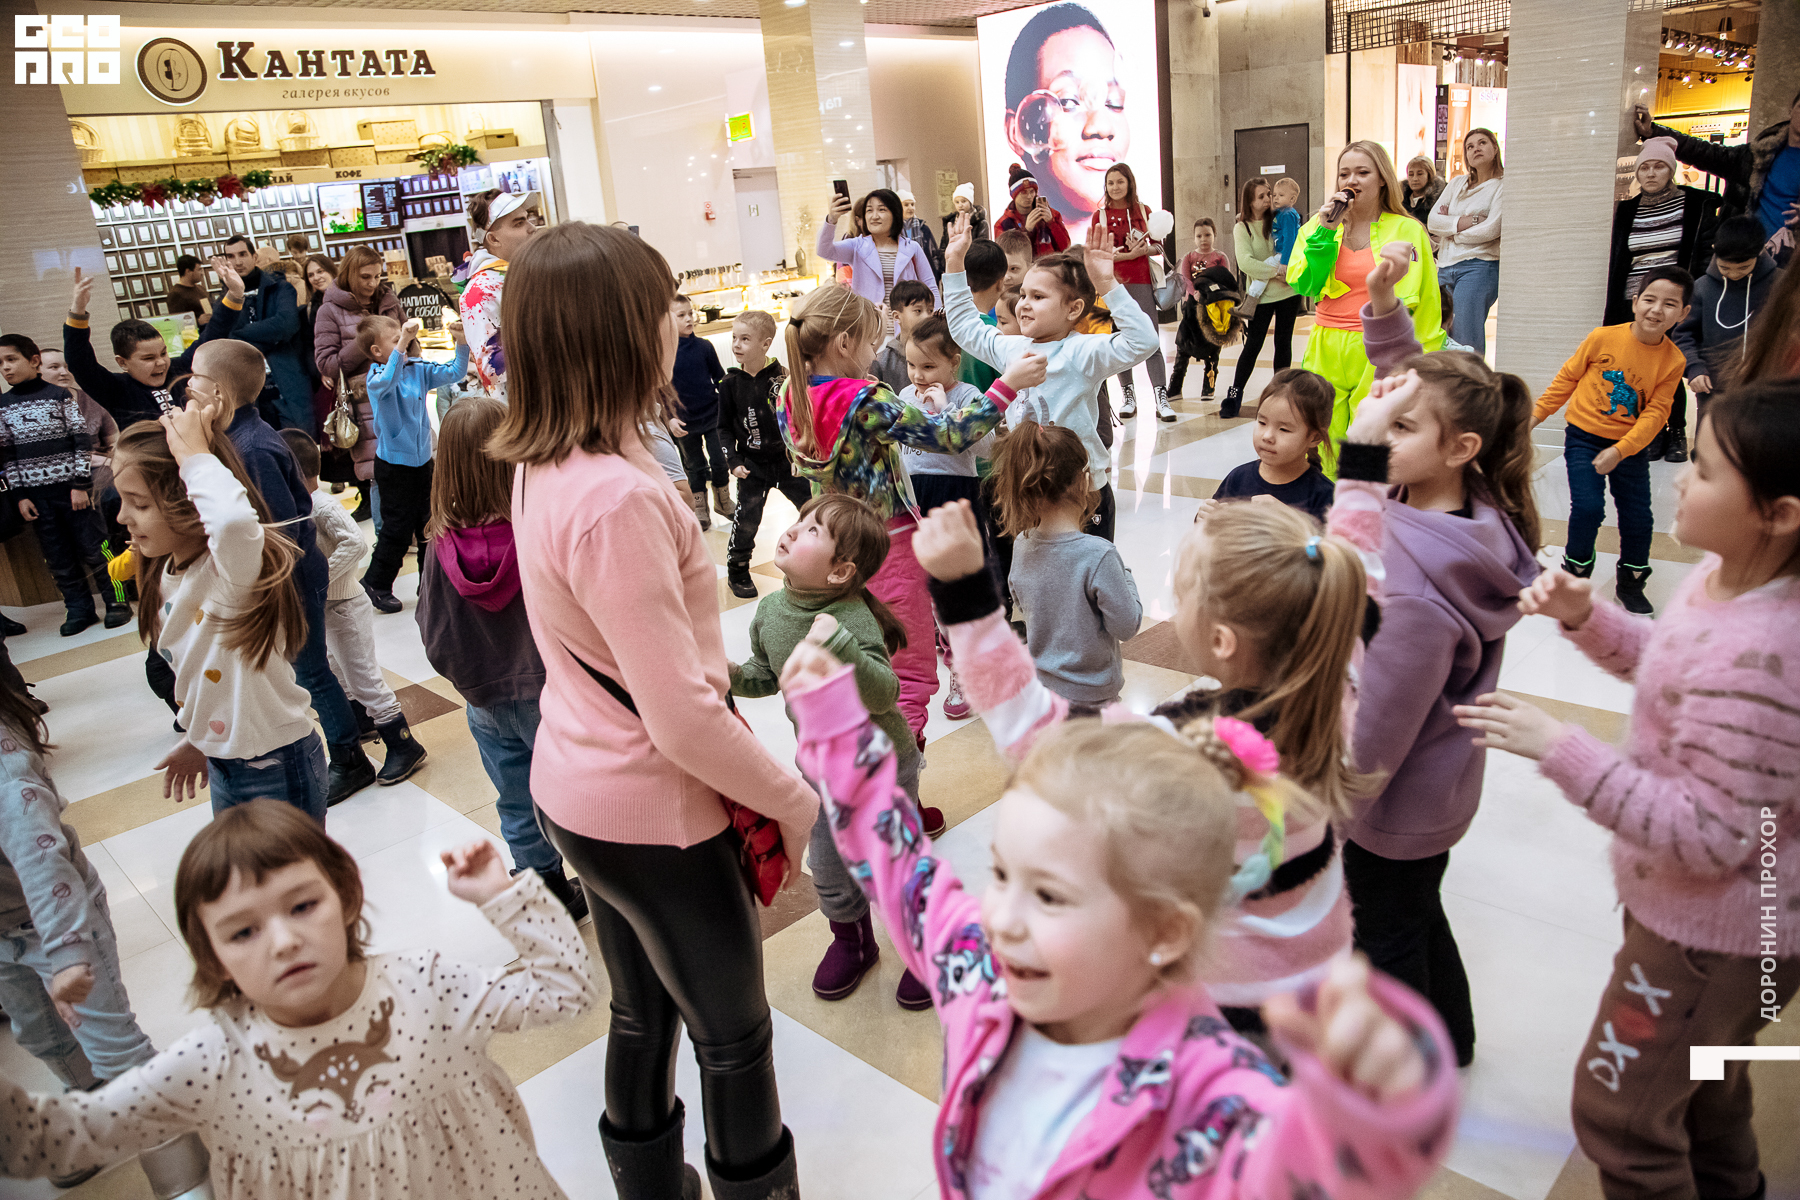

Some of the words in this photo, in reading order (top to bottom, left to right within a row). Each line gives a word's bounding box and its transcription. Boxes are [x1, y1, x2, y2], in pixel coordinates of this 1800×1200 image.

[282, 88, 340, 101] галерея
[344, 87, 390, 100] вкусов
[335, 170, 362, 178] КОФЕ
[400, 295, 439, 307] НАПИТКИ
[748, 406, 758, 427] over
